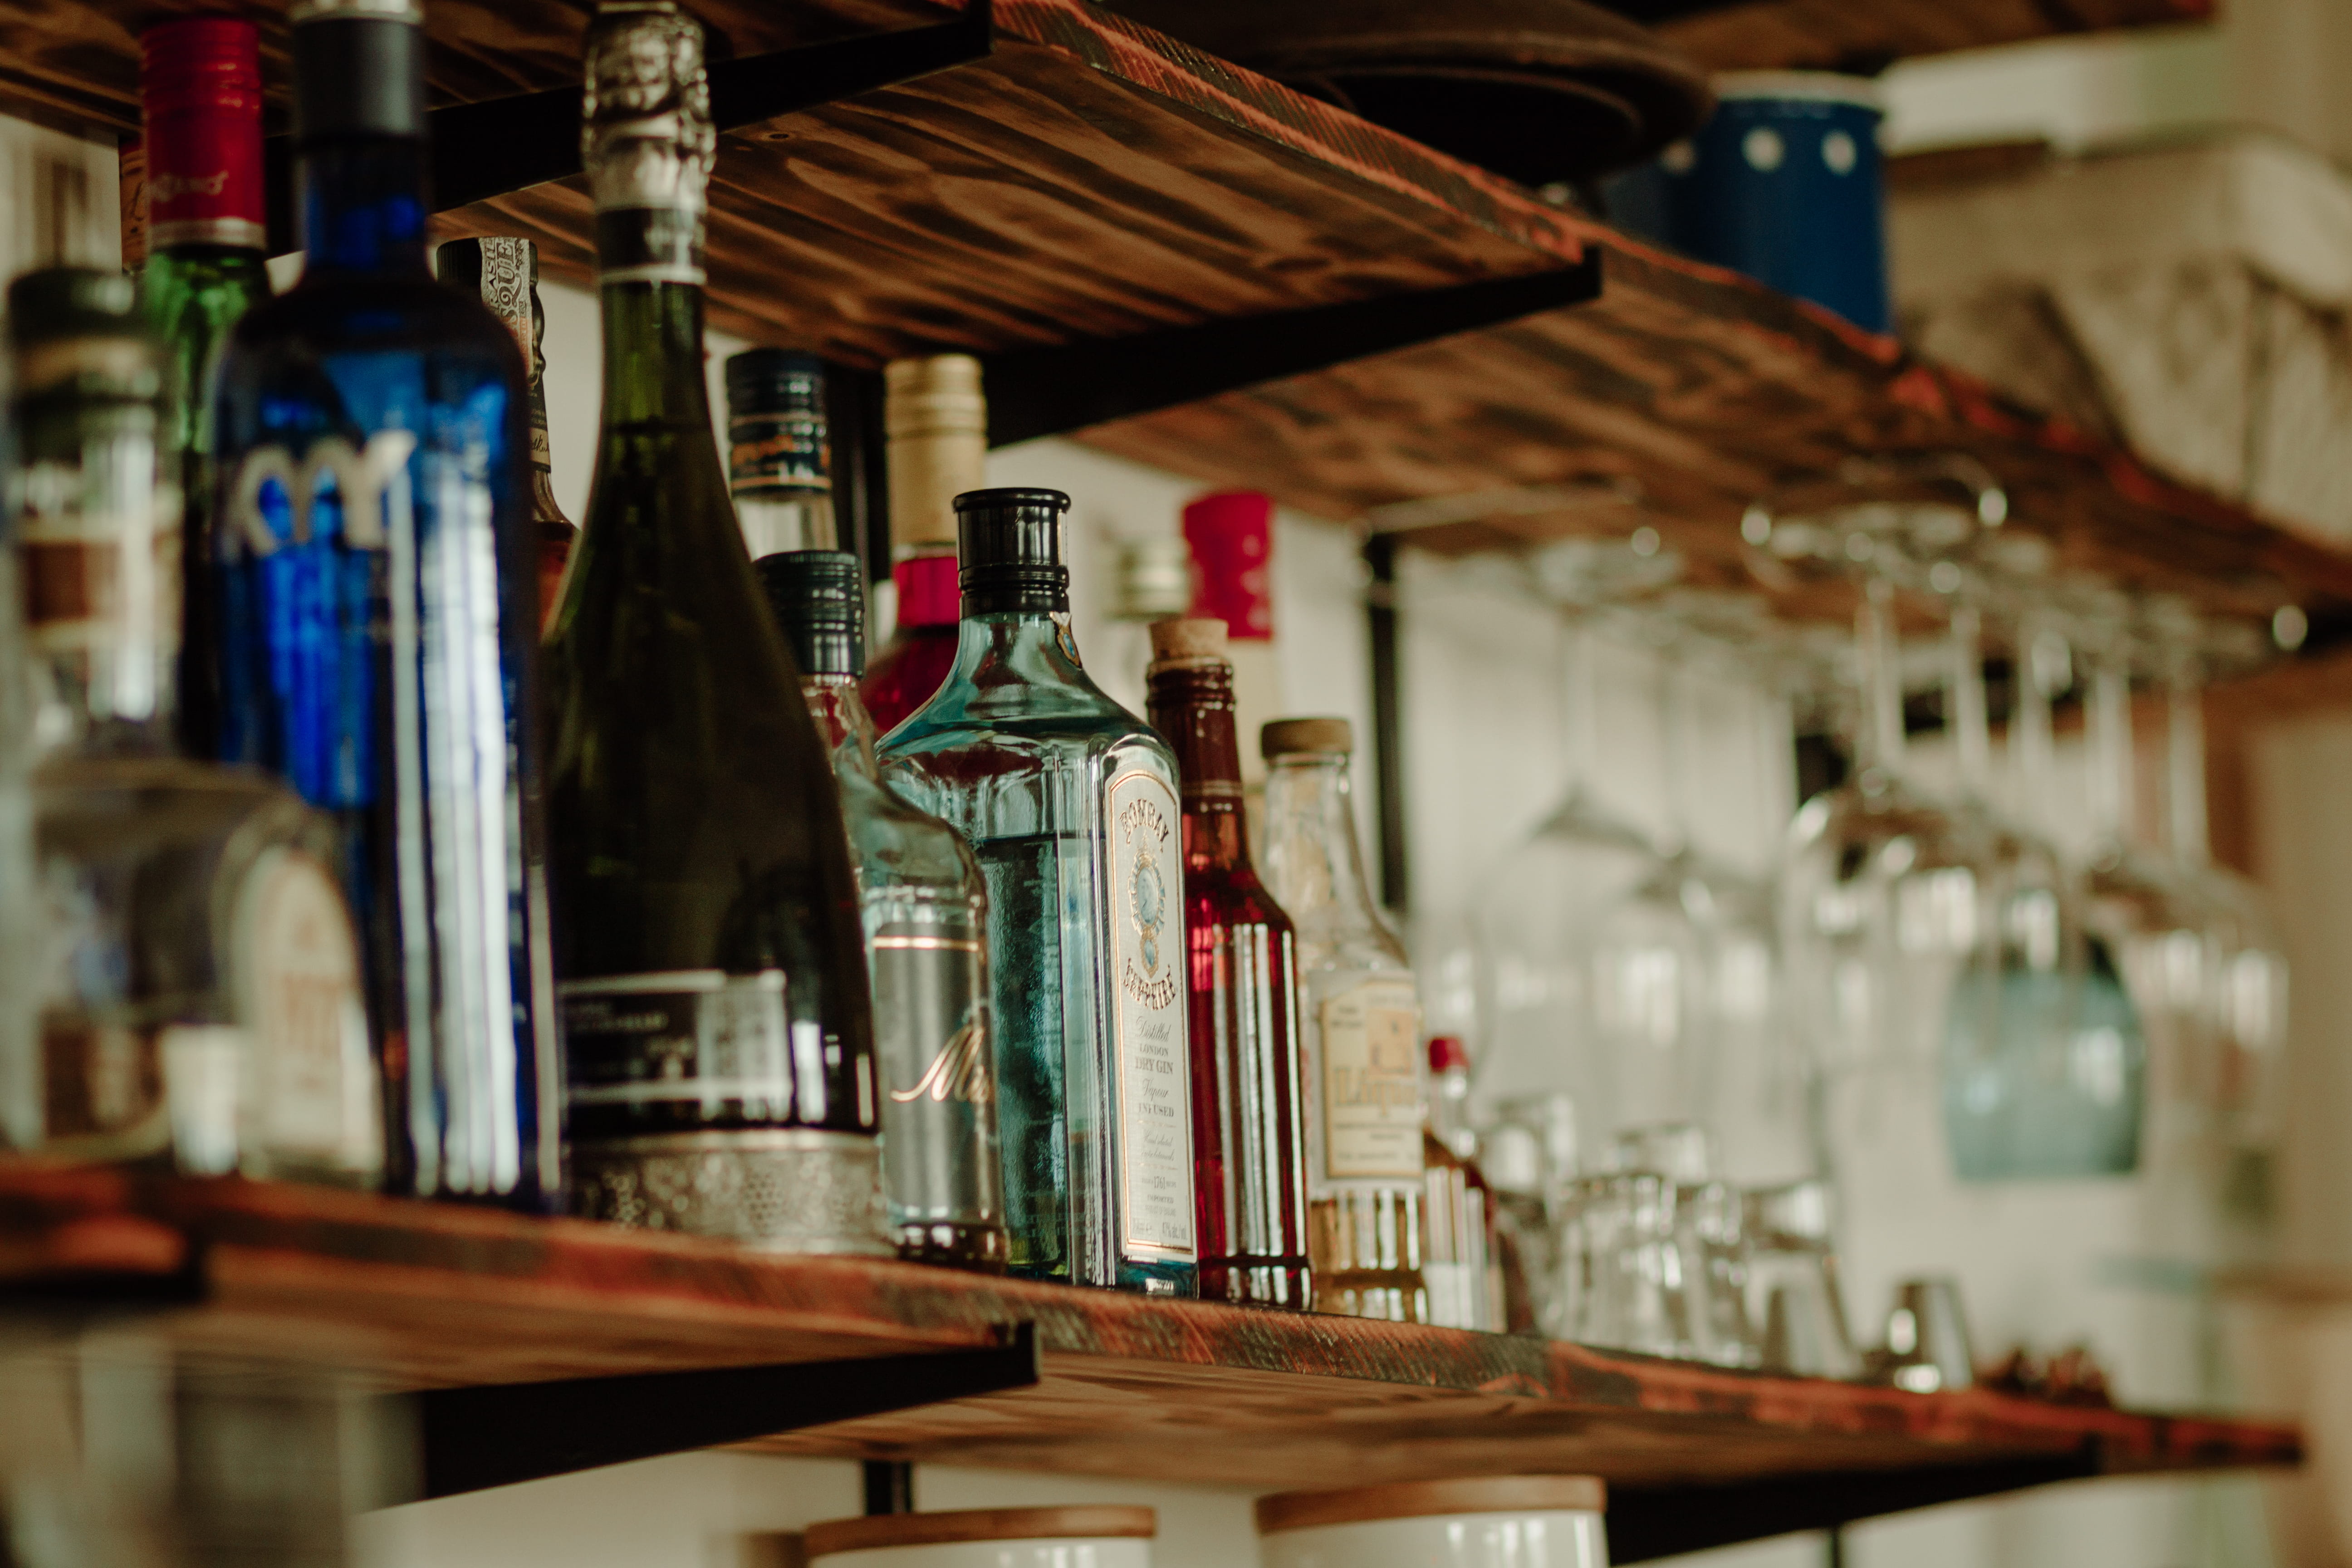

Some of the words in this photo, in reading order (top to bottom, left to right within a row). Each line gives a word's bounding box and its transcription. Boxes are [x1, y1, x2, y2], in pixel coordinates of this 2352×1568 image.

[1119, 798, 1170, 853] BOMBAY
[1122, 957, 1176, 1011] SAPPHIRE
[1136, 1016, 1171, 1042] Distilled
[1139, 1043, 1169, 1056] LONDON
[1135, 1056, 1155, 1072] DRY
[1156, 1060, 1174, 1075] GIN
[1142, 1078, 1169, 1101] Vapour
[1139, 1103, 1174, 1117] INFUSED
[1154, 1176, 1165, 1190] 1761
